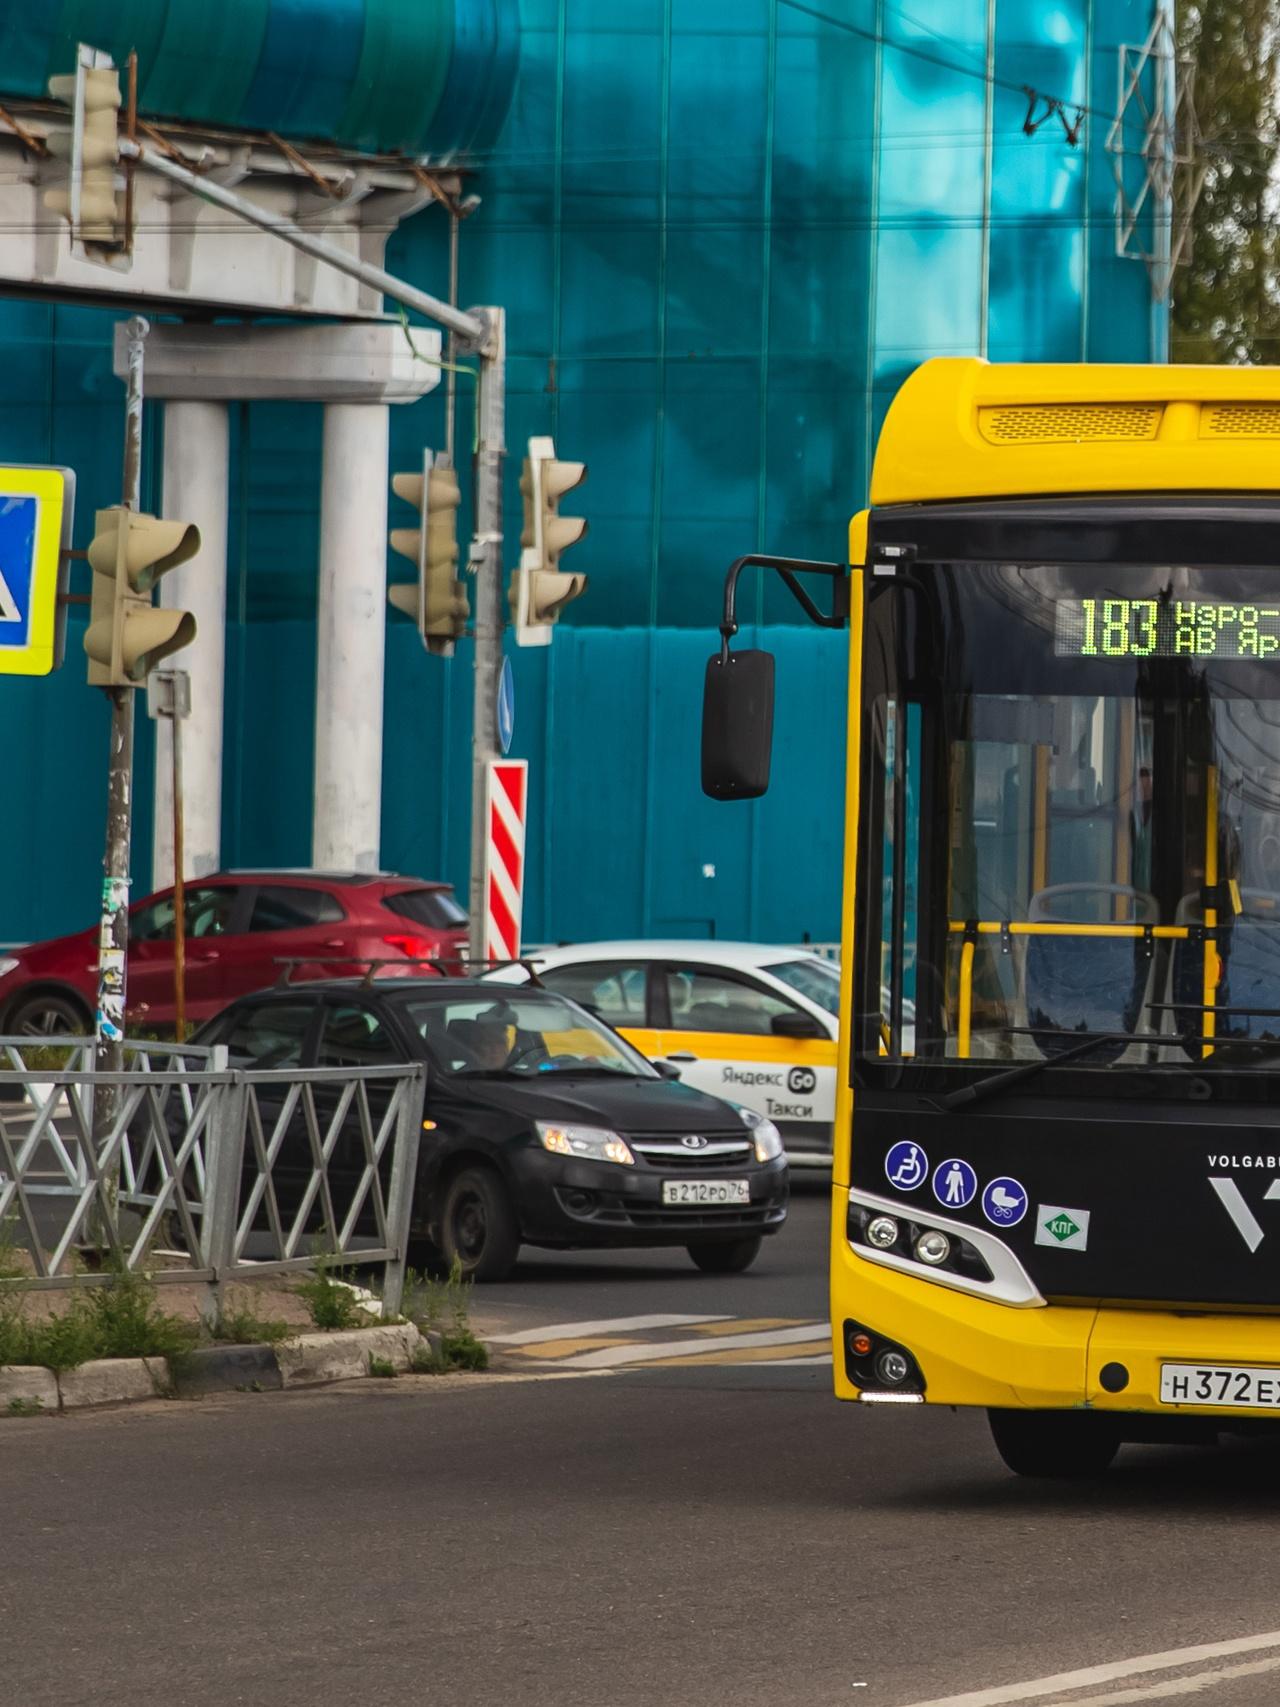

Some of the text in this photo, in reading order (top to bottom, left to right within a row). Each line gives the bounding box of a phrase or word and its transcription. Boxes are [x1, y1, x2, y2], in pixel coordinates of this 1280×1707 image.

[1081, 599, 1158, 656] 183
[1175, 627, 1216, 654] АВ
[723, 1066, 783, 1087] Яндекс
[766, 1098, 813, 1118] Такси
[1051, 1220, 1074, 1235] КПГ
